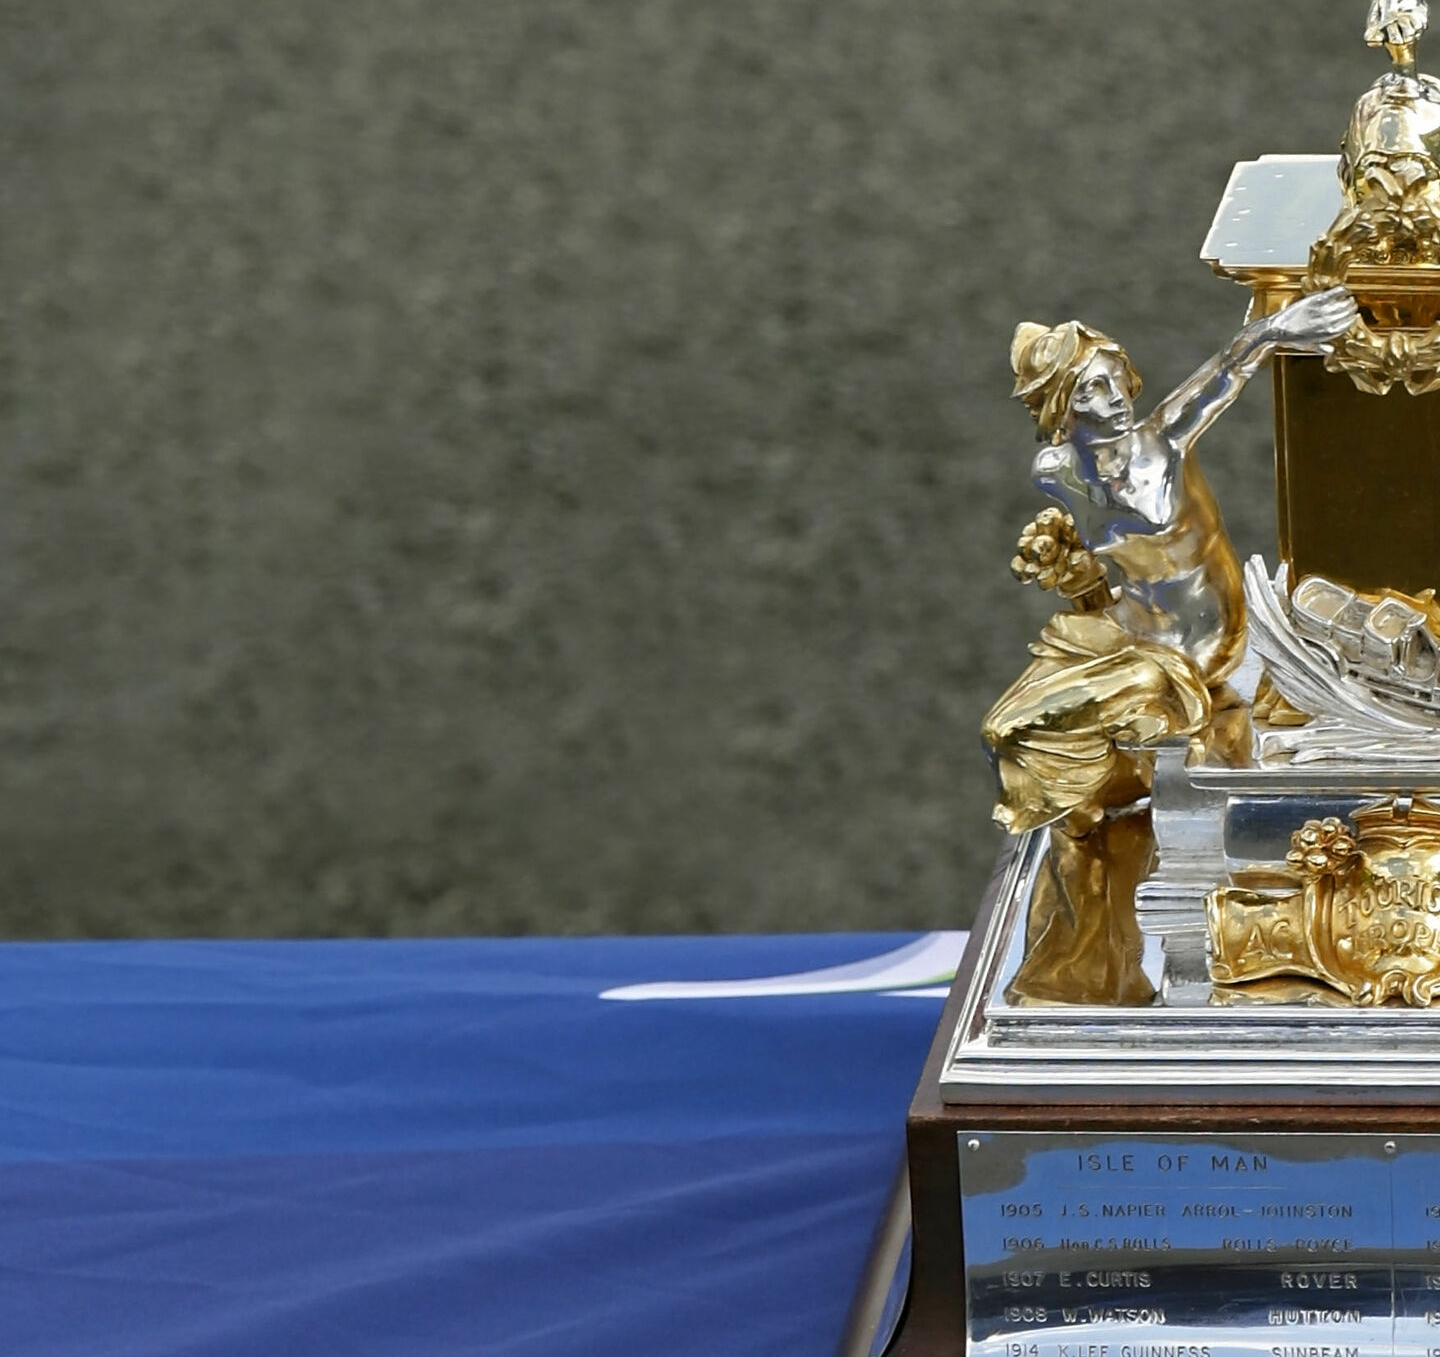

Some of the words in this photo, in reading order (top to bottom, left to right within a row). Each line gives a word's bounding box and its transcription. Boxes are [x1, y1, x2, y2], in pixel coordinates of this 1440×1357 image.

[1077, 1154, 1136, 1172] ISLE
[1157, 1154, 1189, 1172] OF
[1211, 1155, 1268, 1172] MAN
[1001, 1203, 1043, 1218] 1905
[1002, 1237, 1046, 1251] 1906
[1002, 1270, 1047, 1288] 1907
[1280, 1271, 1358, 1289] ROVER
[1003, 1306, 1049, 1324] 1908
[1061, 1307, 1167, 1325] W.WATSON
[1268, 1309, 1362, 1326] HUTTON
[1005, 1343, 1040, 1357] 1914
